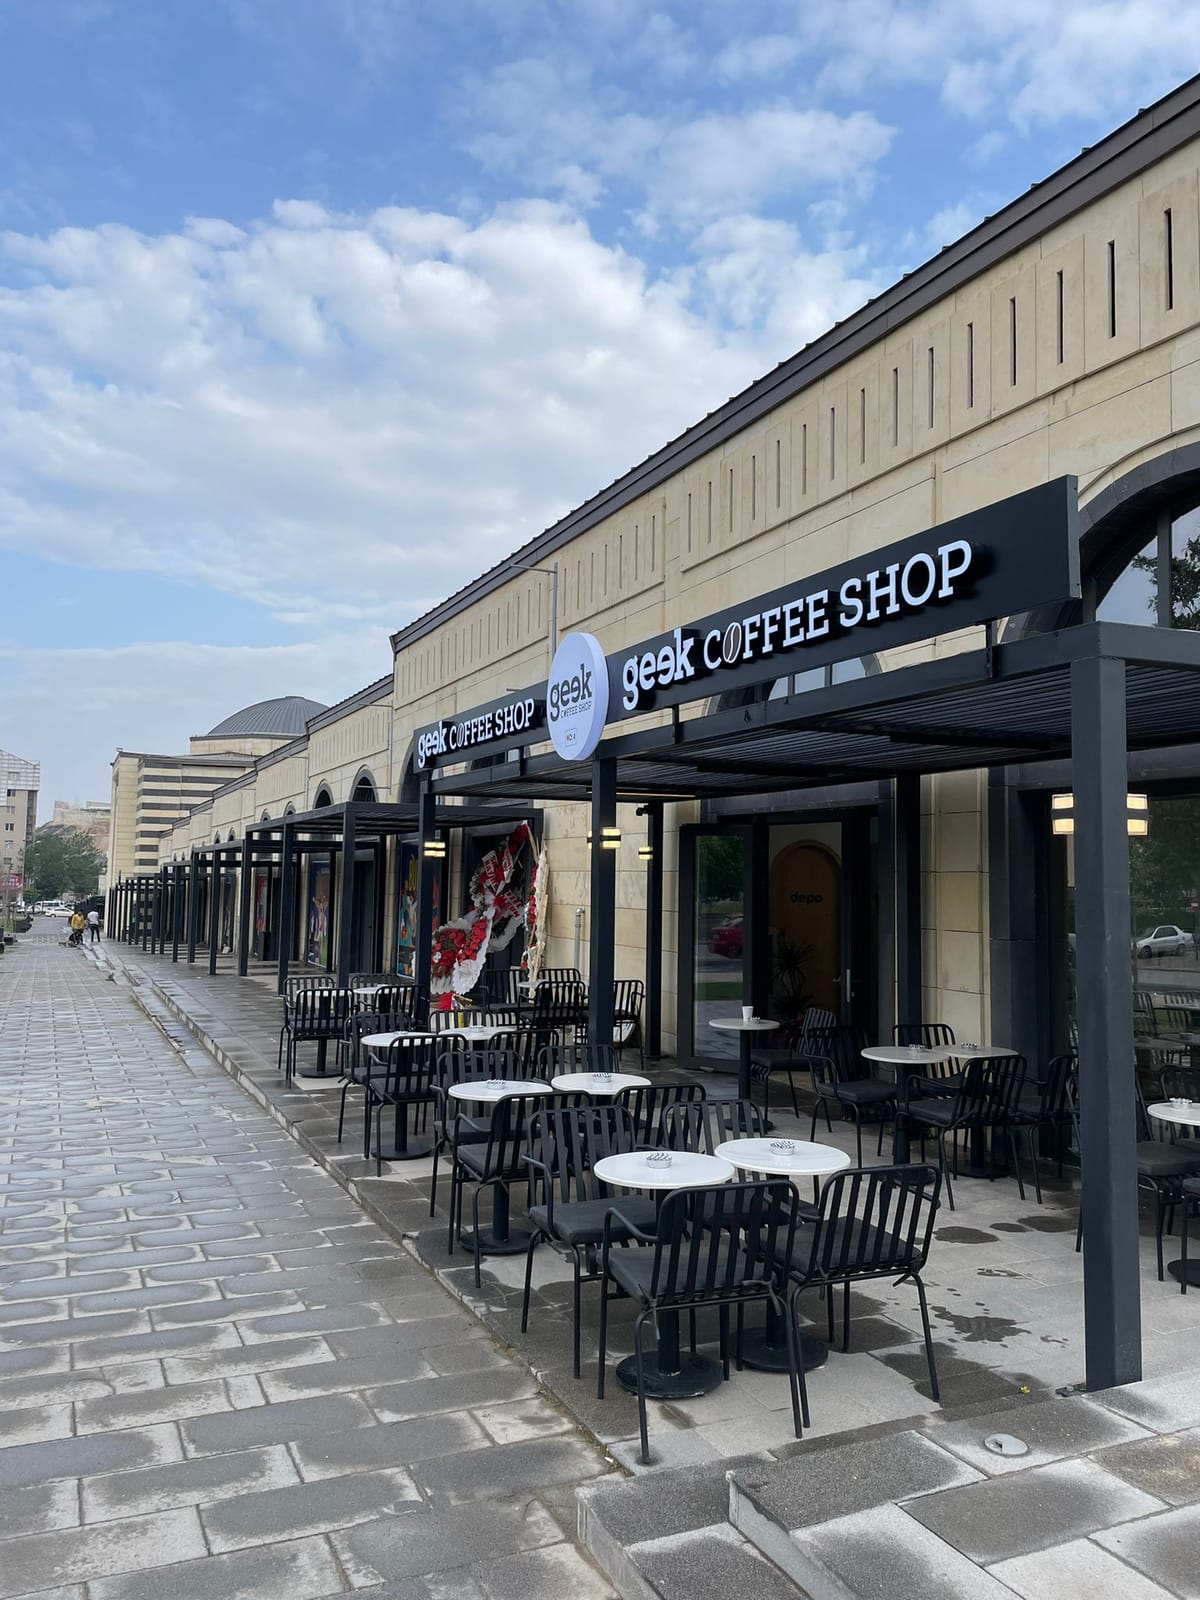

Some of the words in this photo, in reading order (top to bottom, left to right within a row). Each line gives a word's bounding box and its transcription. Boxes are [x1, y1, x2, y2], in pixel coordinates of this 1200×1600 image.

[622, 627, 695, 711] geek
[703, 589, 830, 670] COFFEE
[839, 539, 972, 628] SHOP
[550, 662, 592, 722] geek
[561, 705, 578, 719] COFFEE
[578, 701, 592, 713] SHOP
[418, 720, 447, 769] geek
[449, 712, 493, 750] COFFEE
[495, 698, 534, 736] SHOP
[790, 890, 823, 905] depo
